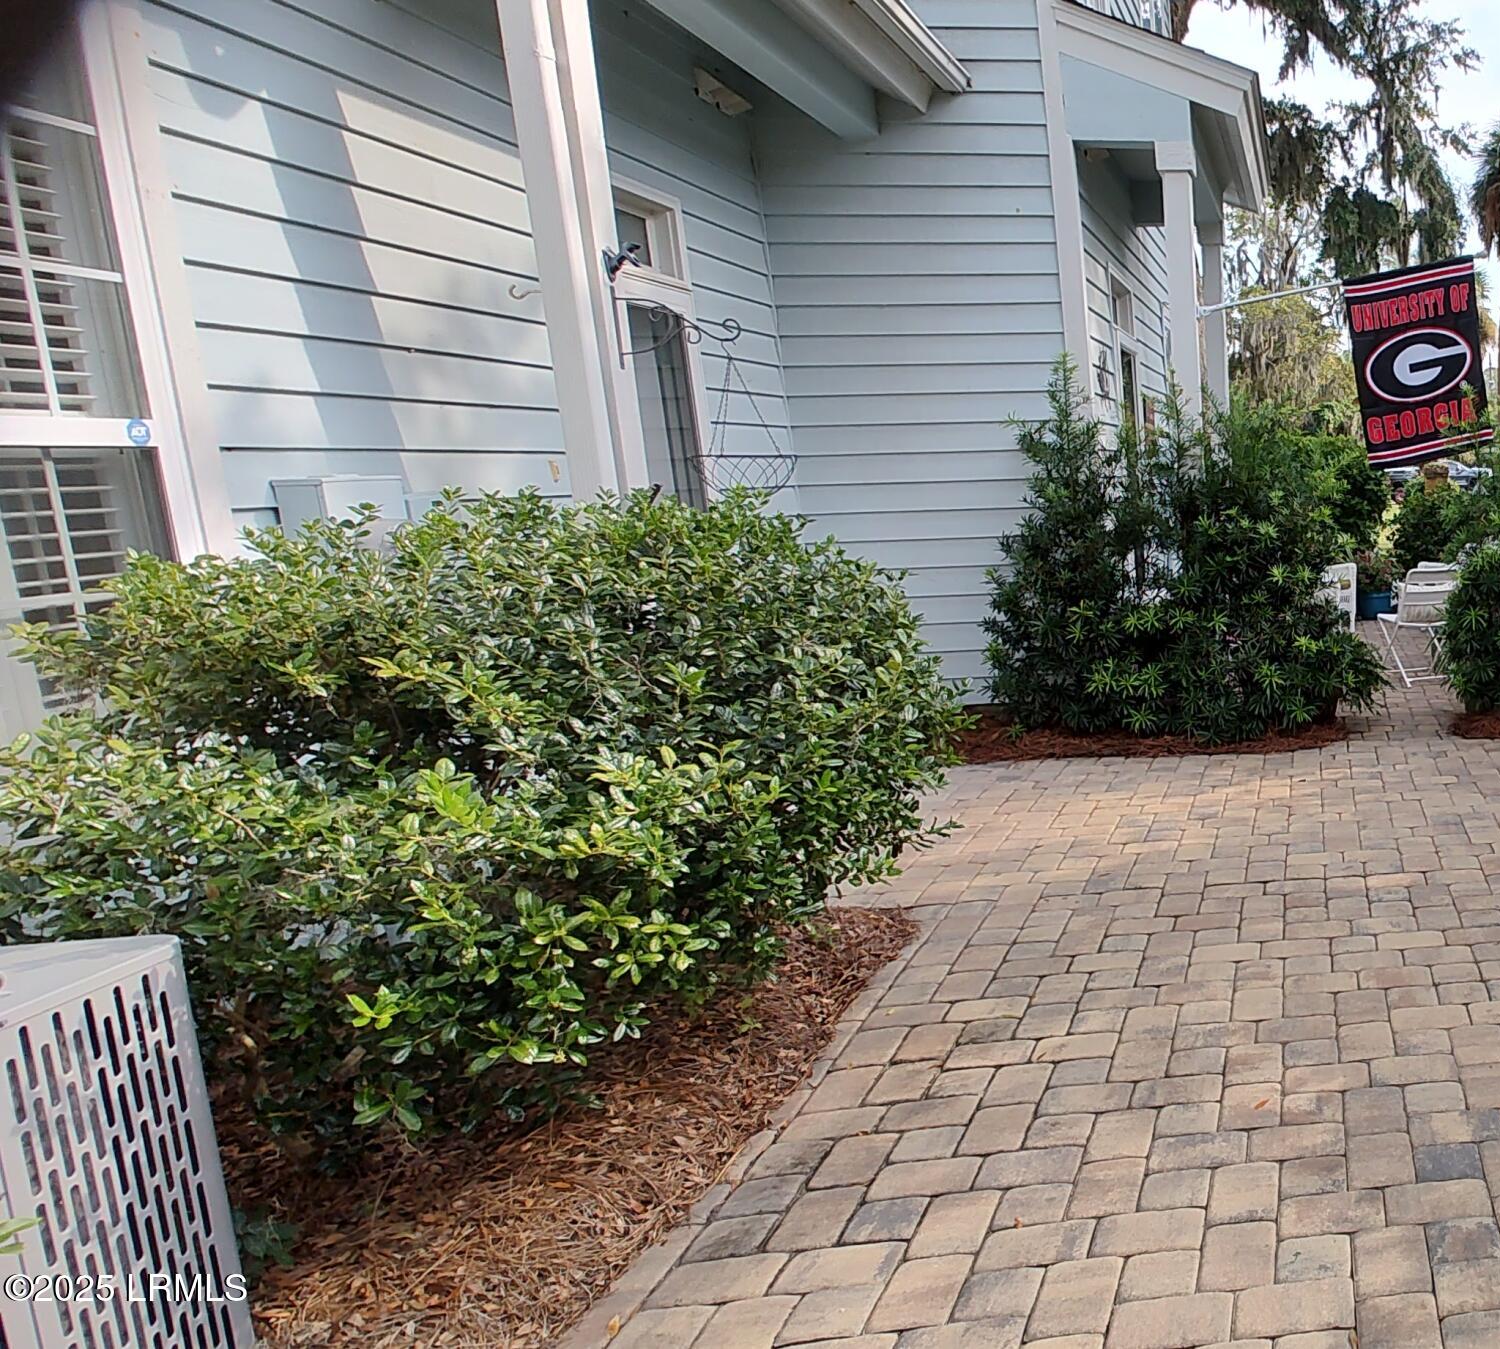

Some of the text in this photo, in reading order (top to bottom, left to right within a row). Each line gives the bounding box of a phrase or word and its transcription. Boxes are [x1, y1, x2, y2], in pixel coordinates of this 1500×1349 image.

[1350, 282, 1470, 333] UNIVERSITY OF
[1369, 332, 1468, 399] G
[1366, 397, 1477, 444] GEORGIA
